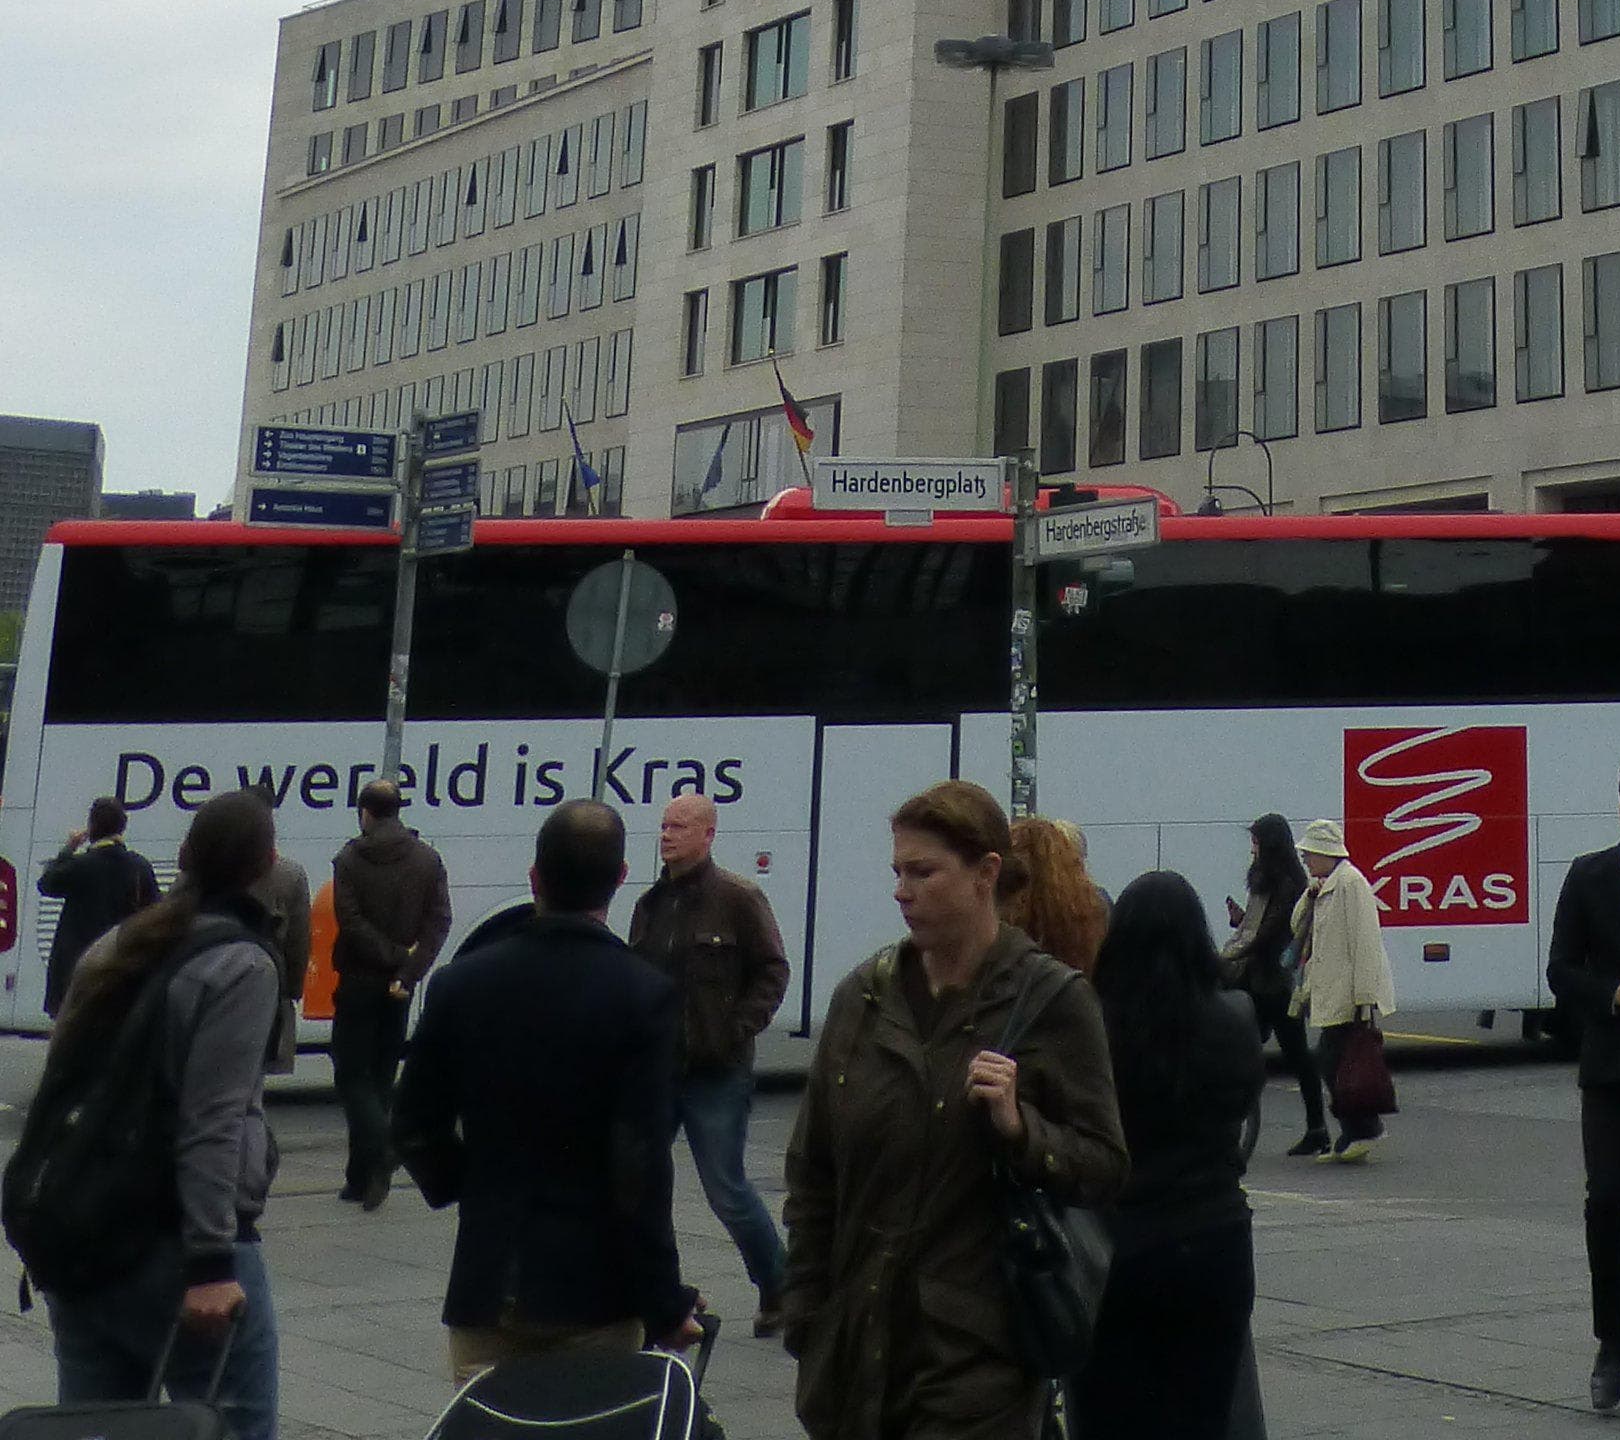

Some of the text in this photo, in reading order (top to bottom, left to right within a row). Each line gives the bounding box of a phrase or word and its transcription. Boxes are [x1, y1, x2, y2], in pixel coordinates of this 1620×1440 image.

[831, 470, 986, 499] Hardenbergplatz
[1045, 508, 1147, 541] Hardenbergstraße
[115, 742, 743, 811] De wereld is Kras
